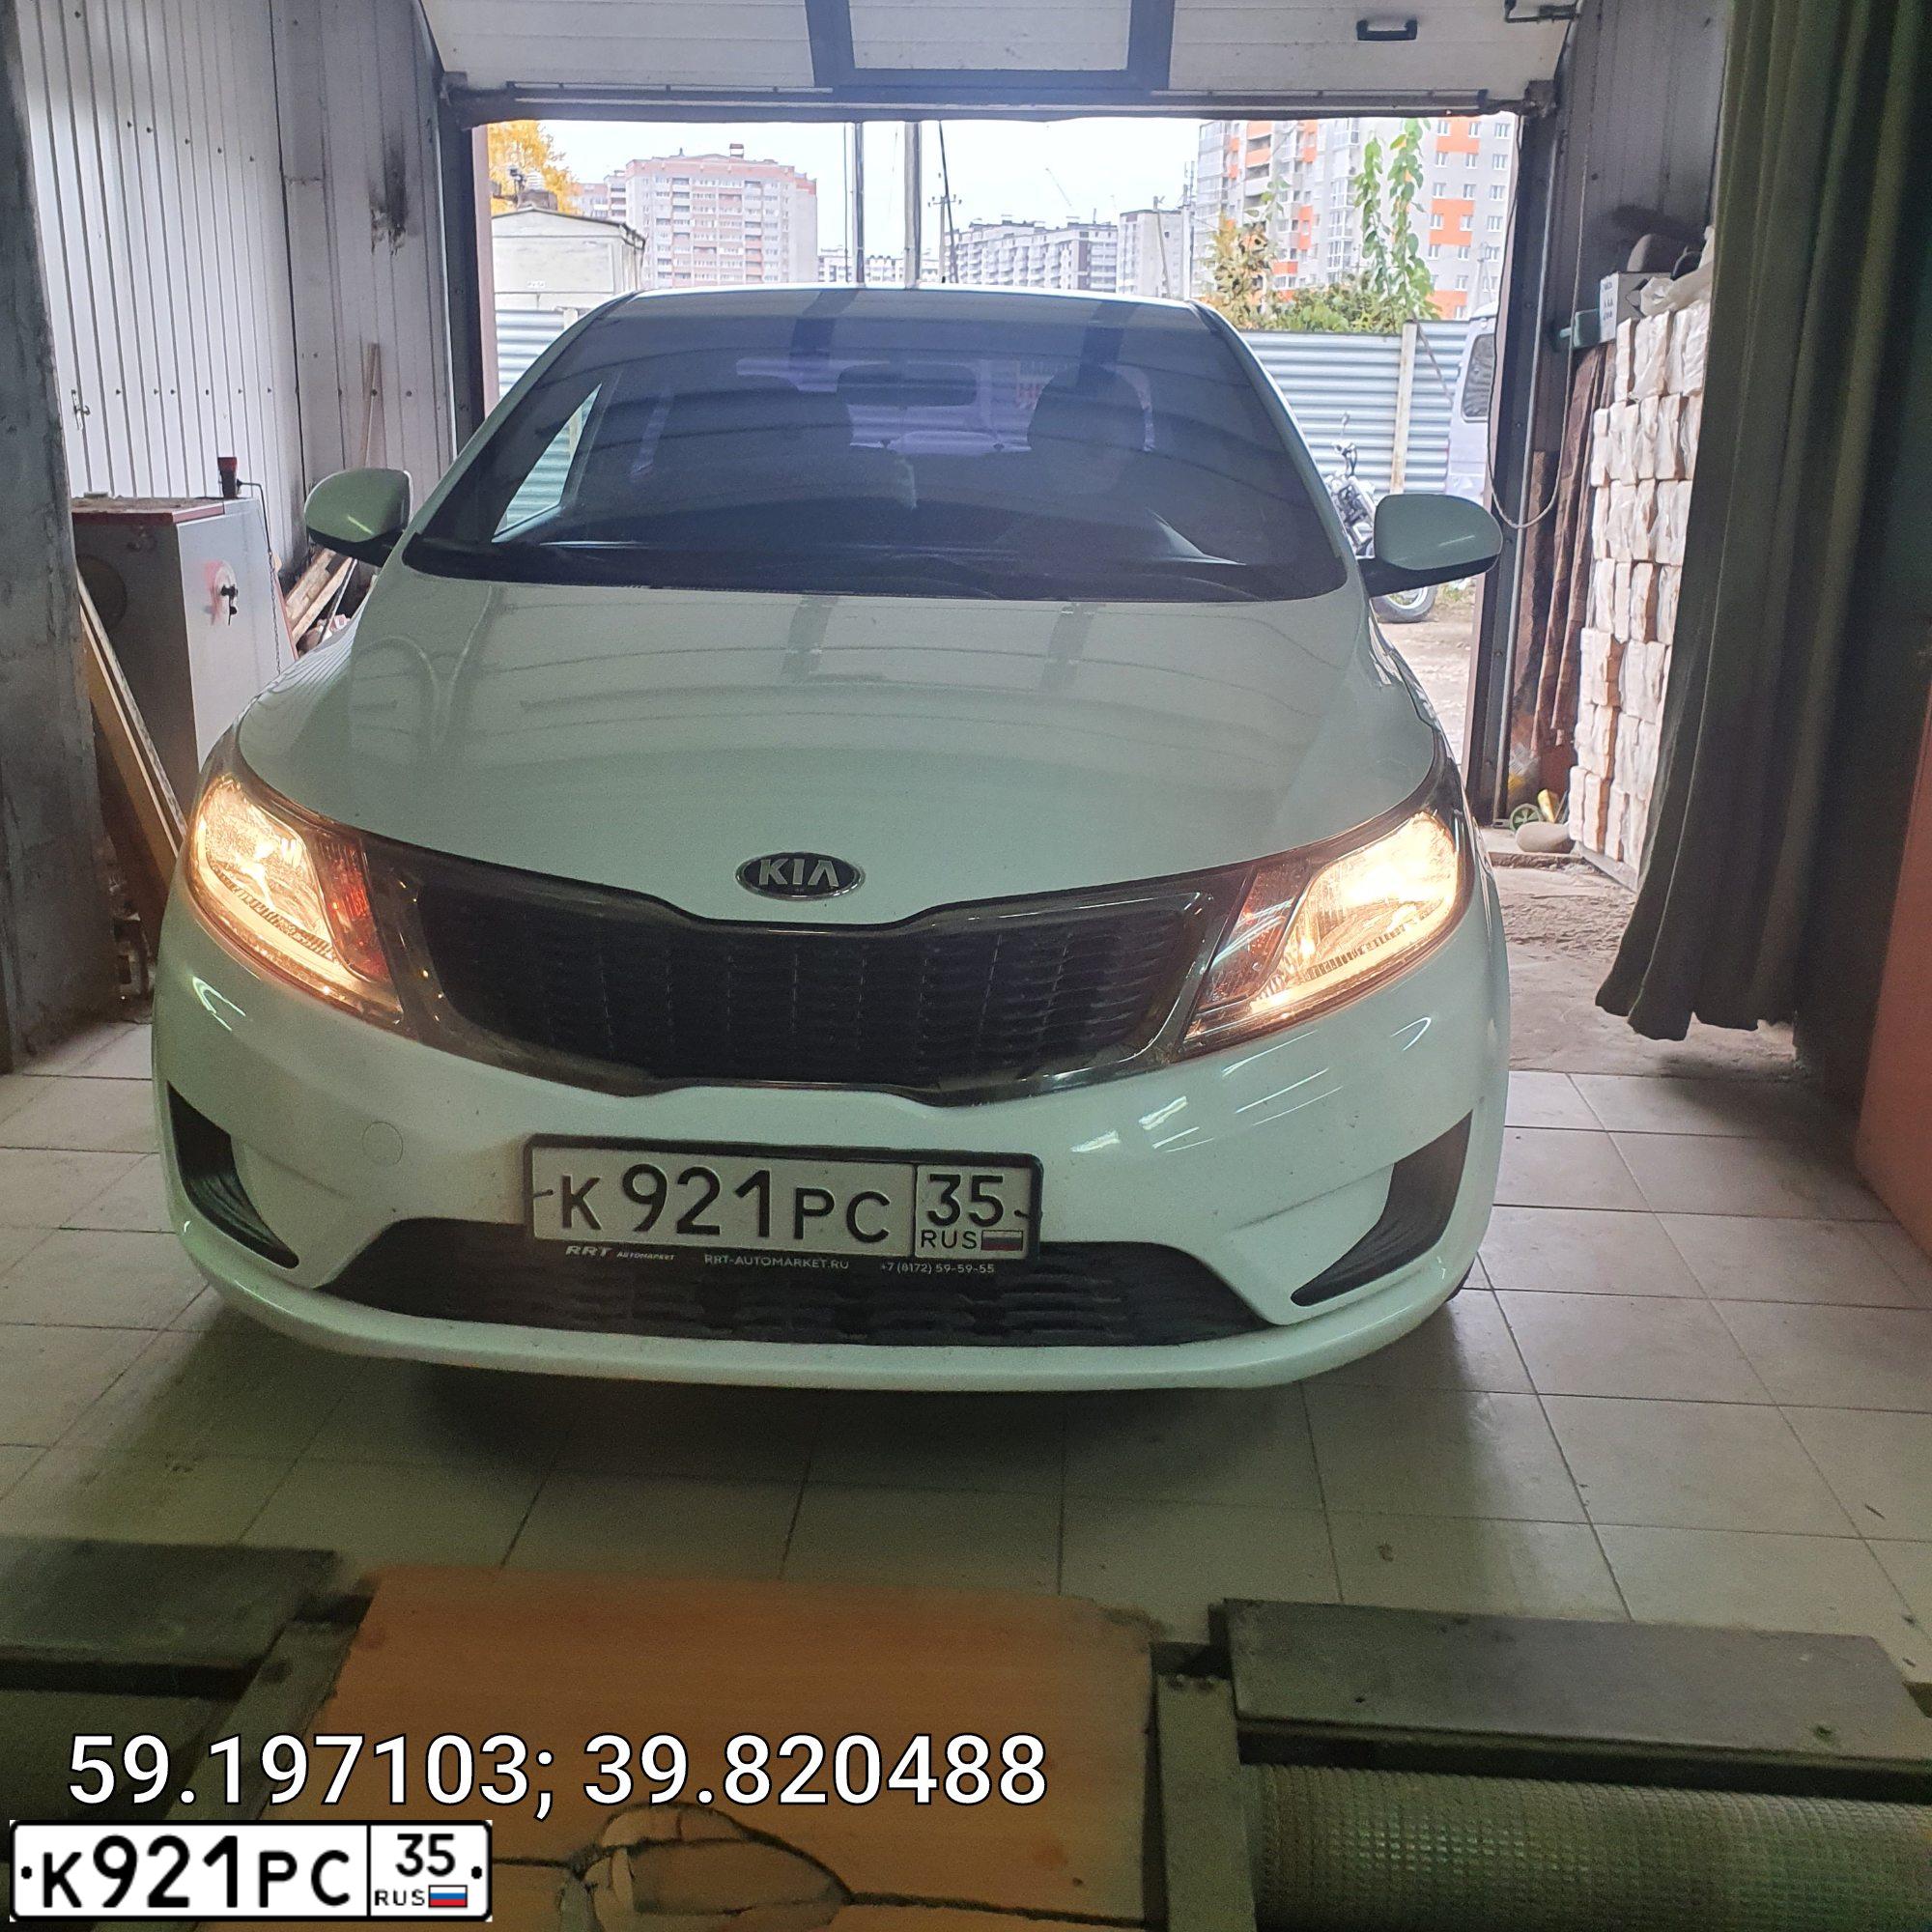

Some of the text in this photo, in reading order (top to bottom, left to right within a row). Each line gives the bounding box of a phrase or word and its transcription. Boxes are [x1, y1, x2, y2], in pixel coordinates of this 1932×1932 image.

[759, 858, 839, 886] KIA
[926, 1174, 1005, 1227] 35
[920, 1229, 979, 1249] RUS
[565, 1244, 612, 1257] RRT
[704, 1254, 849, 1270] RRT-AUTOMARKET.RU
[935, 1264, 995, 1274] 59-59-55
